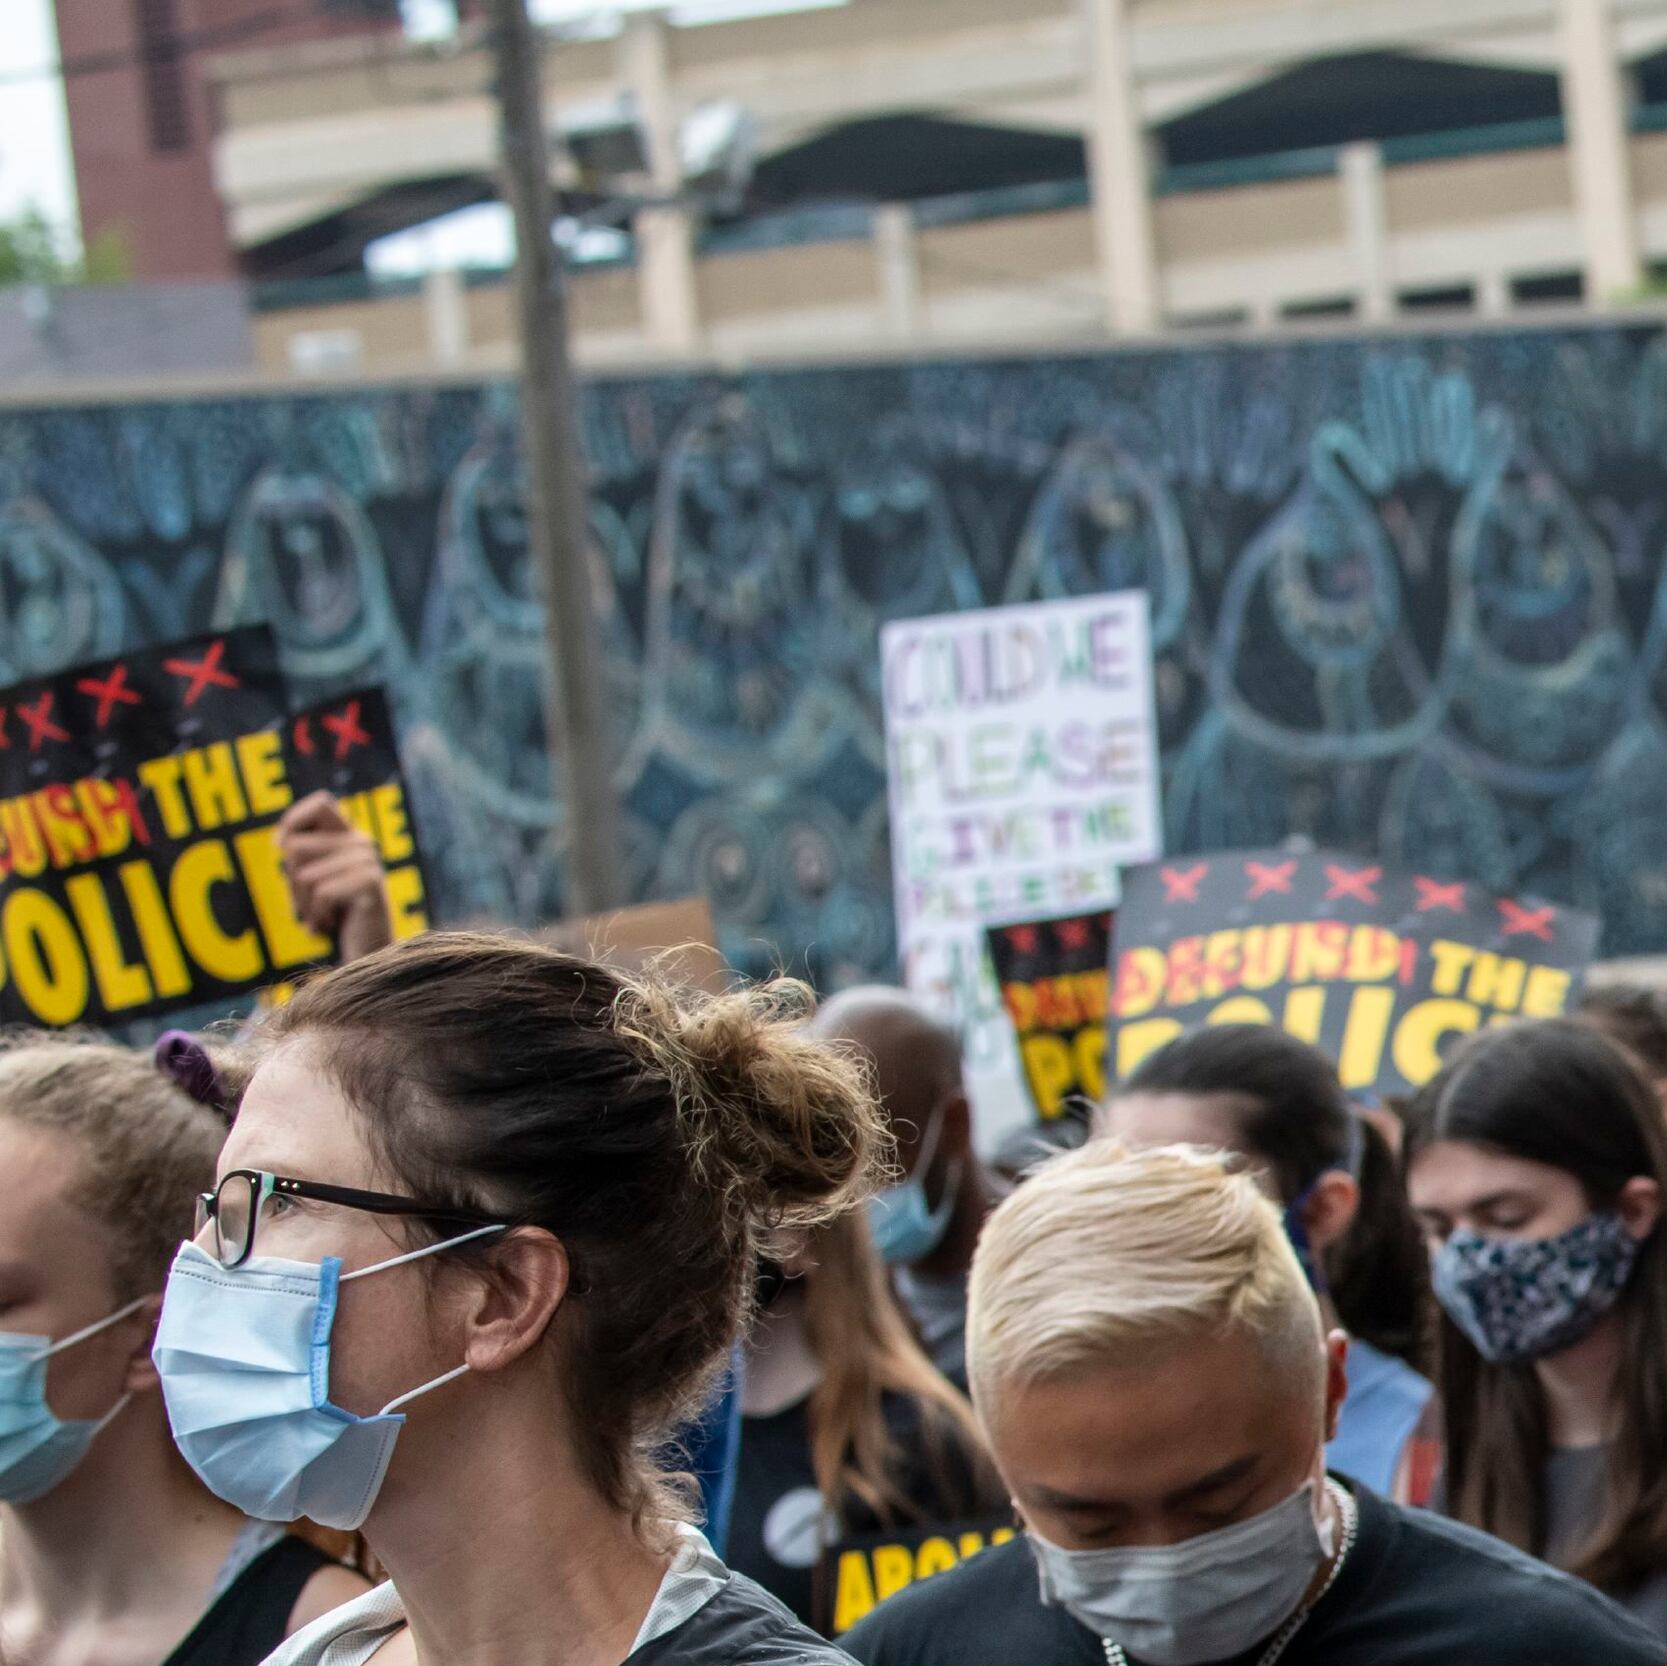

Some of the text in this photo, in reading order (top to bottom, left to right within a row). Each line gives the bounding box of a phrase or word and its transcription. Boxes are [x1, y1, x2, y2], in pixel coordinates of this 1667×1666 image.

[137, 728, 293, 840] THE
[898, 718, 1144, 802] PLEASE
[0, 824, 332, 1026] OLICE
[1429, 938, 1571, 1018] THE
